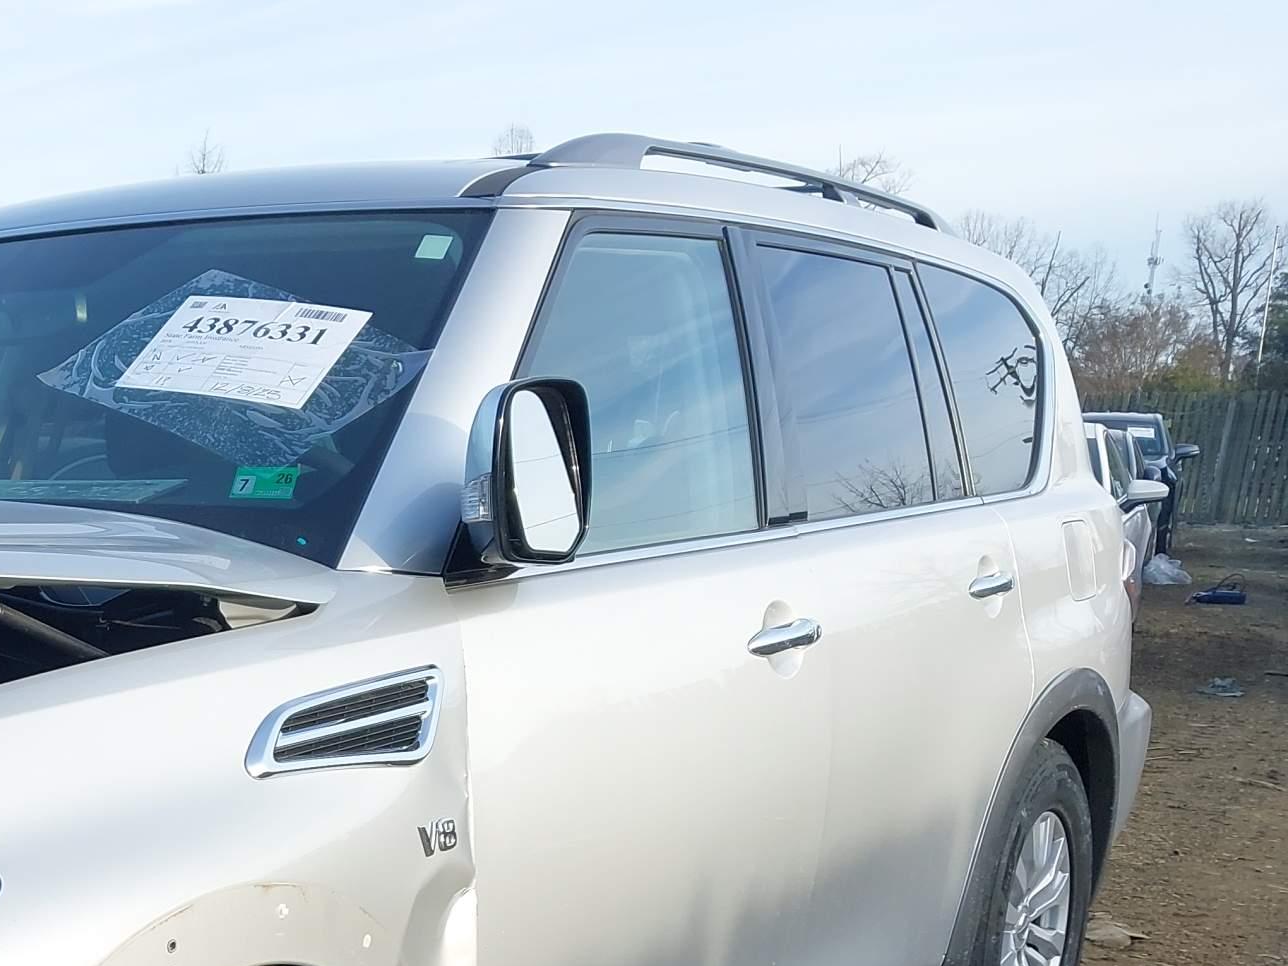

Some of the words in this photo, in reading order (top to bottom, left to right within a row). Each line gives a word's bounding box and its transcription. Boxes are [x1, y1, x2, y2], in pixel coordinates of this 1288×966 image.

[182, 316, 328, 345] 43876331
[240, 479, 250, 491] 7
[276, 474, 293, 484] 26
[417, 817, 457, 857] V8
